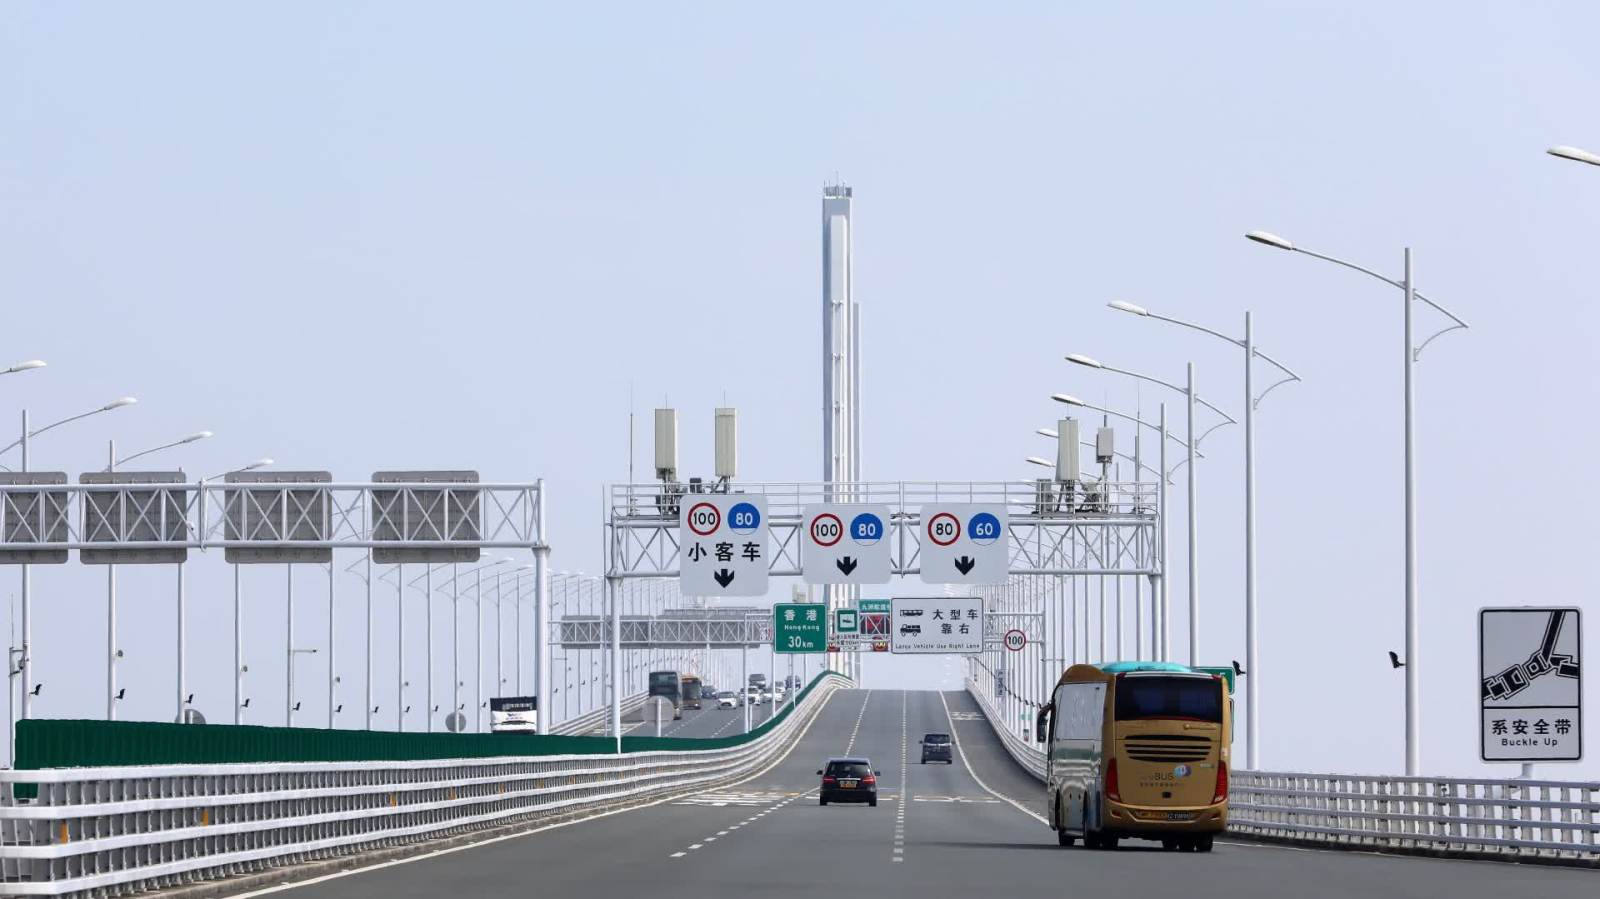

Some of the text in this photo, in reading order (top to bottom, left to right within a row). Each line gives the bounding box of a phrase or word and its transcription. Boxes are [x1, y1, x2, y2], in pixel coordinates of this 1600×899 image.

[693, 512, 716, 526] 100
[735, 512, 753, 526] 80
[815, 523, 838, 537] 100
[858, 523, 876, 536] 80
[935, 523, 953, 536] 80
[975, 523, 993, 536] 60
[688, 541, 761, 562] 小客车
[784, 609, 817, 621] 香港
[933, 609, 979, 620] 大型车
[784, 624, 820, 632] Hong Kong
[941, 623, 970, 634] 靠右
[1007, 636, 1023, 645] 100
[1491, 718, 1572, 735] 系安全带
[1501, 738, 1558, 747] Buckle Up
